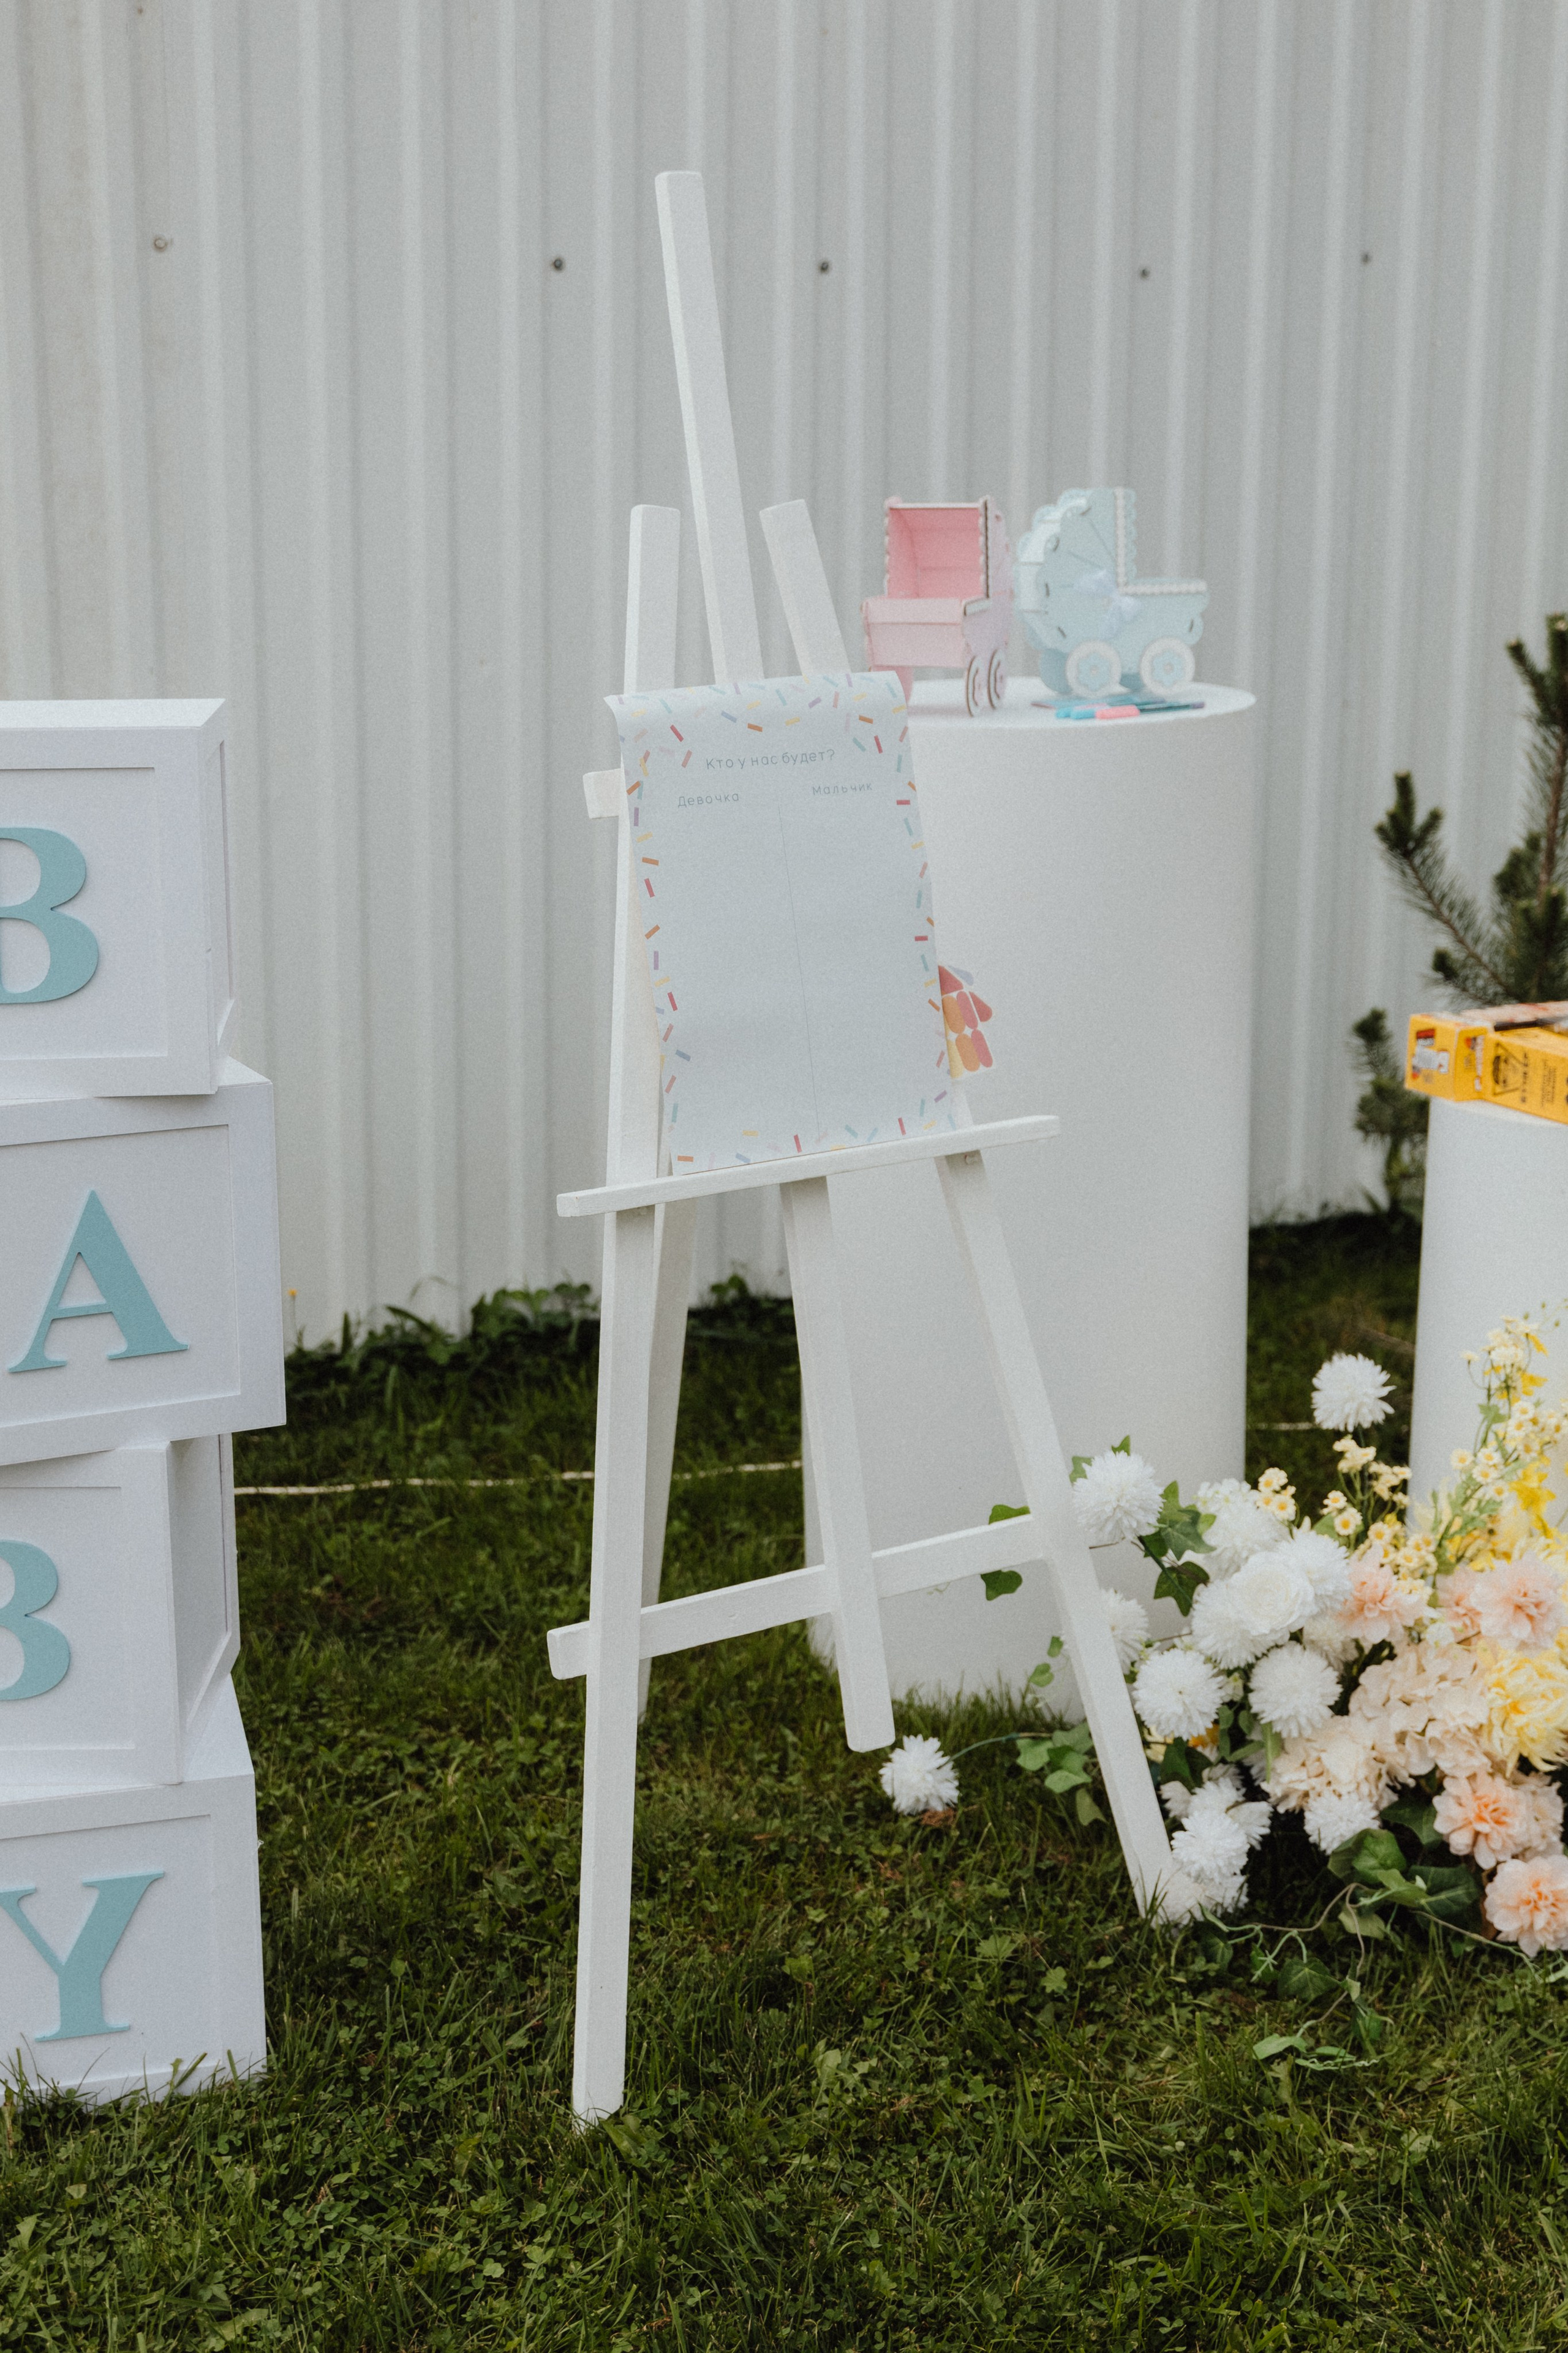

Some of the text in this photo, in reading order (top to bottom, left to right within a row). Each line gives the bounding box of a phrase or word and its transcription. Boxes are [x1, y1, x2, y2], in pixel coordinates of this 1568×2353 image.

[706, 749, 835, 769] Кто у нас будет?
[812, 783, 873, 796] Мальчик
[677, 793, 739, 808] Девочка
